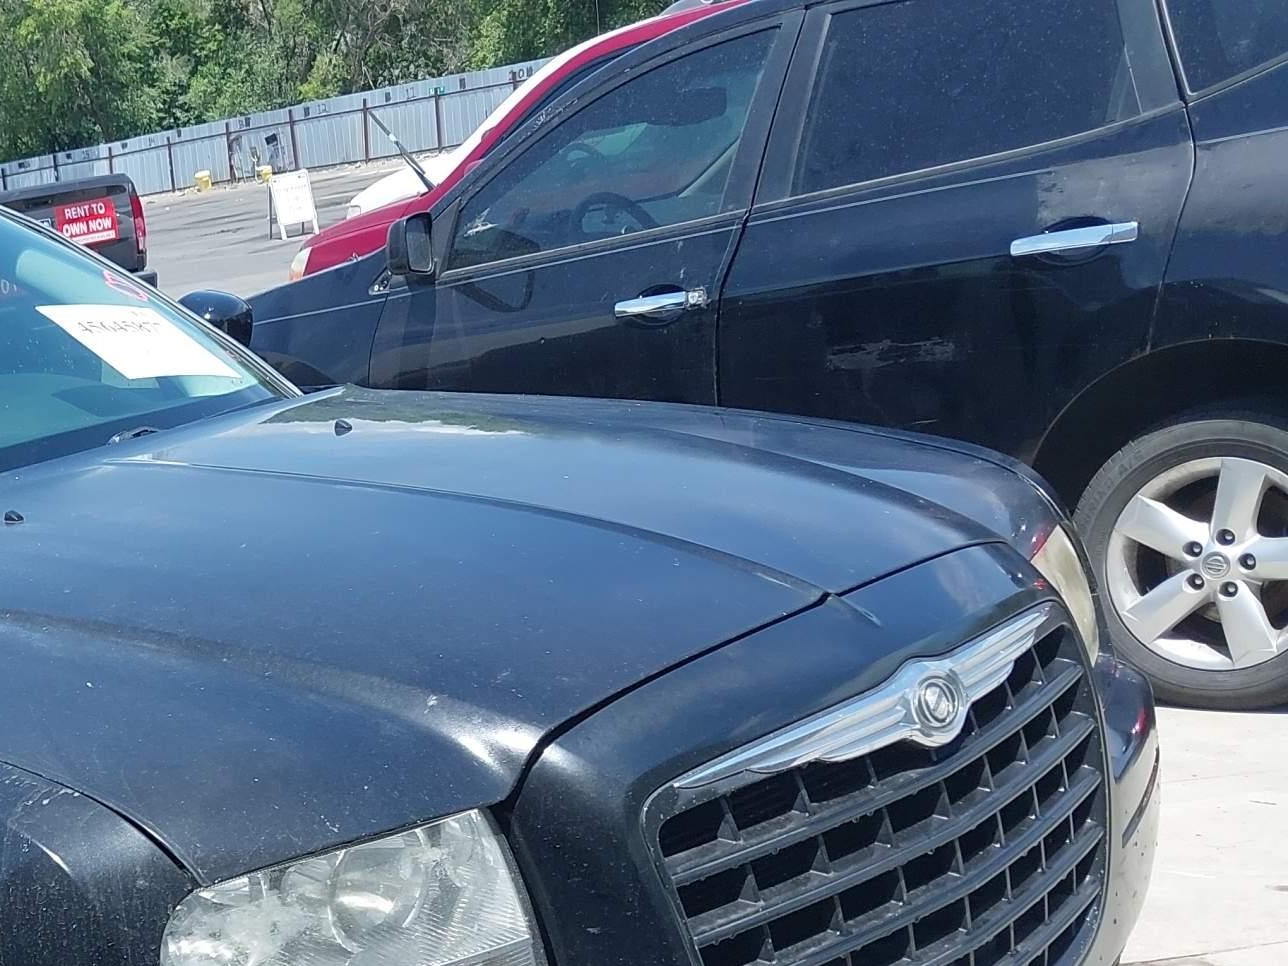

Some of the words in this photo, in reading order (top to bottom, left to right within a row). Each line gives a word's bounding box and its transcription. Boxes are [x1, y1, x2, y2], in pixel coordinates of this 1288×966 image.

[64, 205, 90, 220] RENT
[91, 202, 106, 215] TO
[62, 221, 87, 237] OWN
[89, 217, 112, 232] NOW
